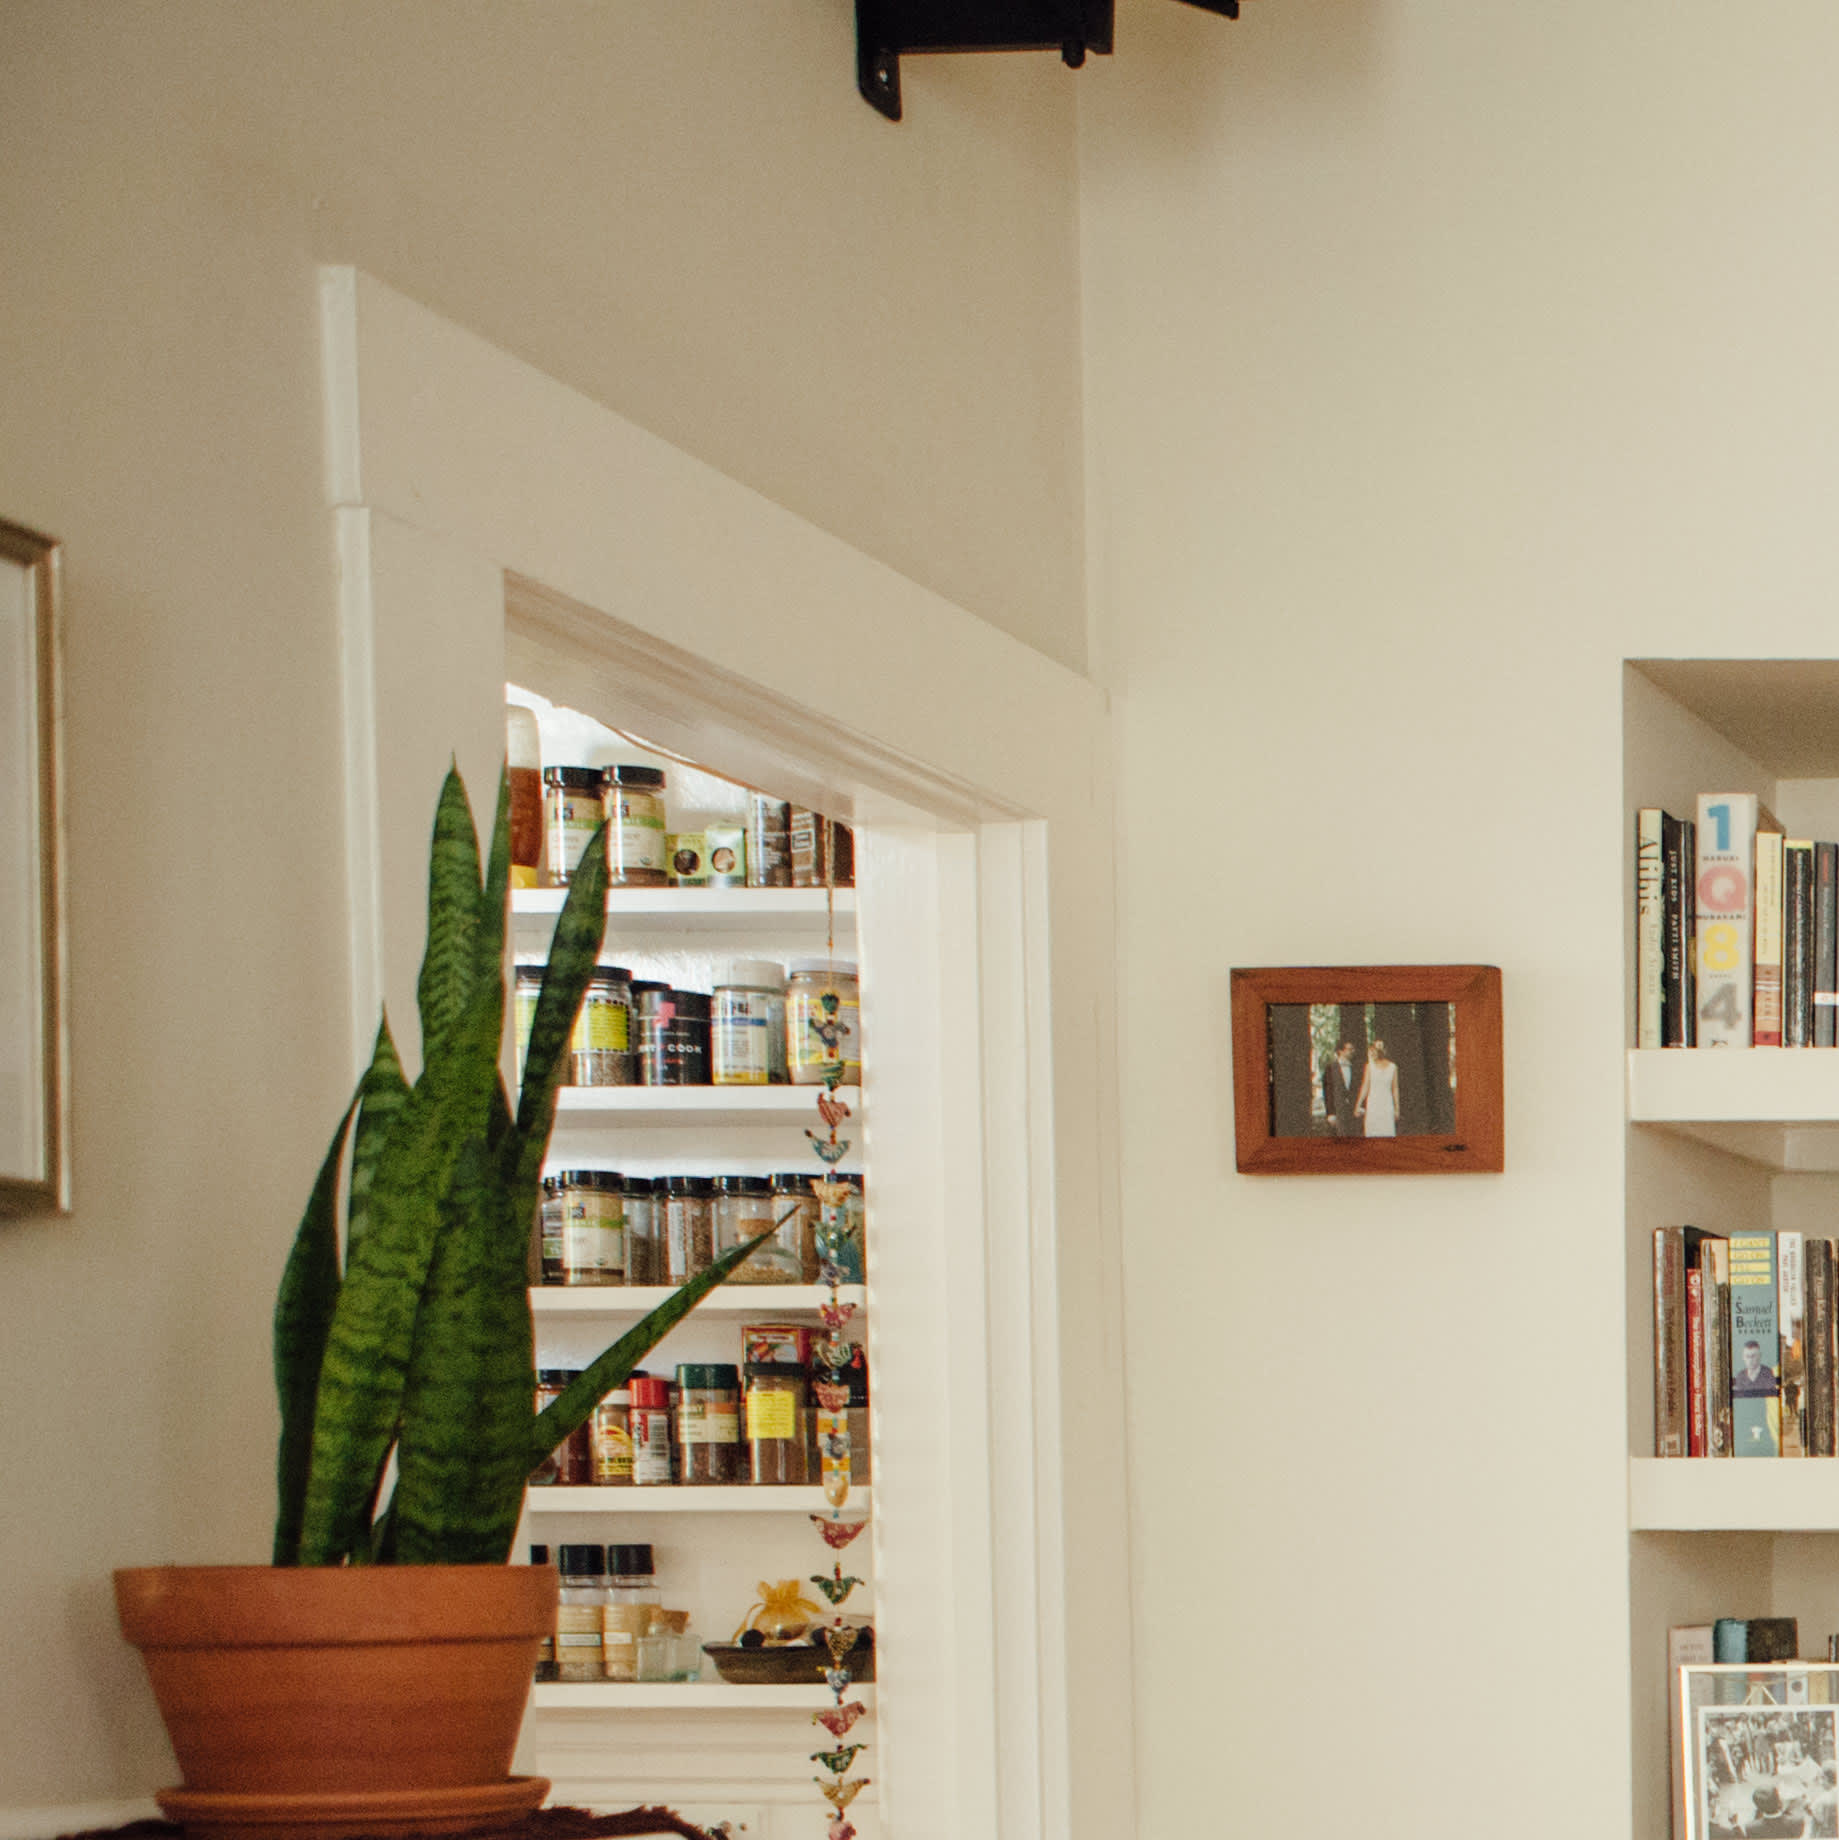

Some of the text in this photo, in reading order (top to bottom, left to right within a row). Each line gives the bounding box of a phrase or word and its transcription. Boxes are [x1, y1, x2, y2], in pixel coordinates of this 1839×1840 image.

[1707, 804, 1731, 851] 1
[1639, 836, 1658, 916] Alibis
[1698, 865, 1748, 912] Q
[1671, 914, 1680, 980] PATTI SMITH
[1703, 923, 1740, 971] 8
[1700, 983, 1743, 1031] 4
[1735, 1302, 1773, 1314] Samuel
